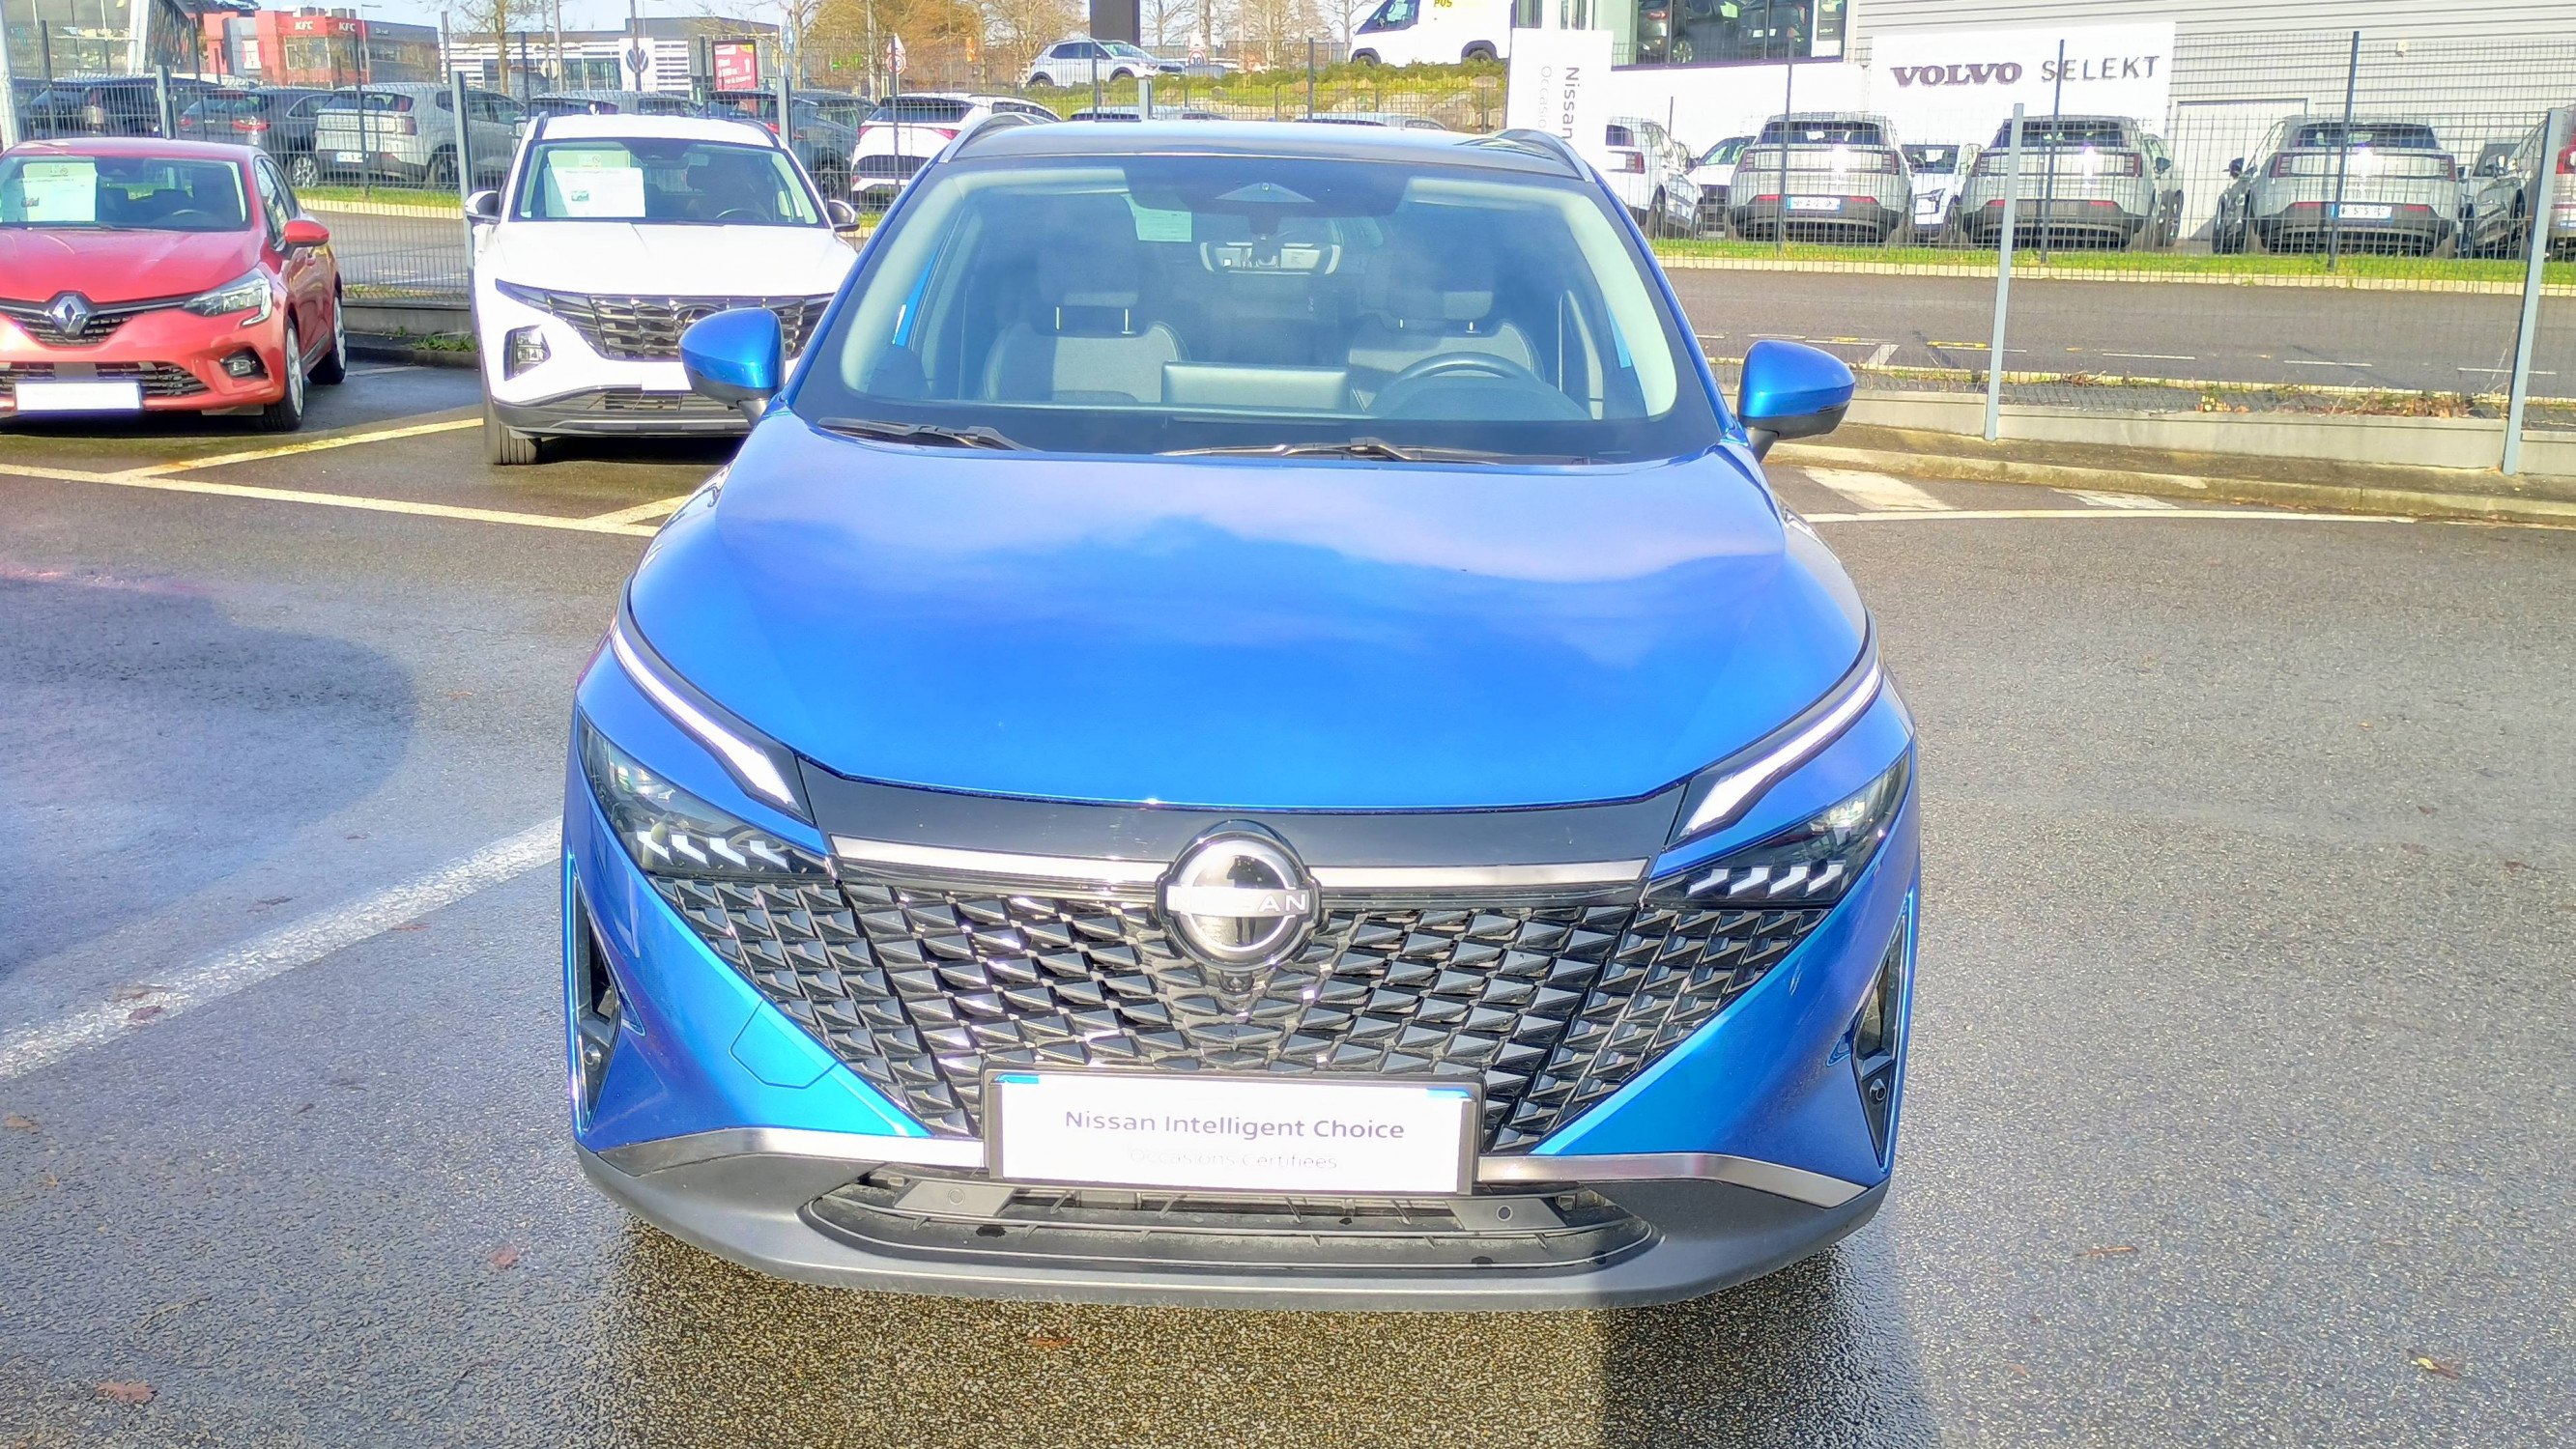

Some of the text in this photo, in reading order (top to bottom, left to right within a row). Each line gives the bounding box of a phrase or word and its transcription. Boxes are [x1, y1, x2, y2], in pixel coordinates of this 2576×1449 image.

[295, 21, 313, 30] KFC
[338, 22, 356, 32] KFC
[1890, 62, 2022, 88] VOLVO
[2041, 55, 2161, 83] SELEKT
[1538, 66, 1552, 128] Occasio
[1562, 67, 1580, 139] Nissan
[1066, 1111, 1405, 1141] Nissan Intelligent Choice
[1130, 1148, 1236, 1166] Occasions
